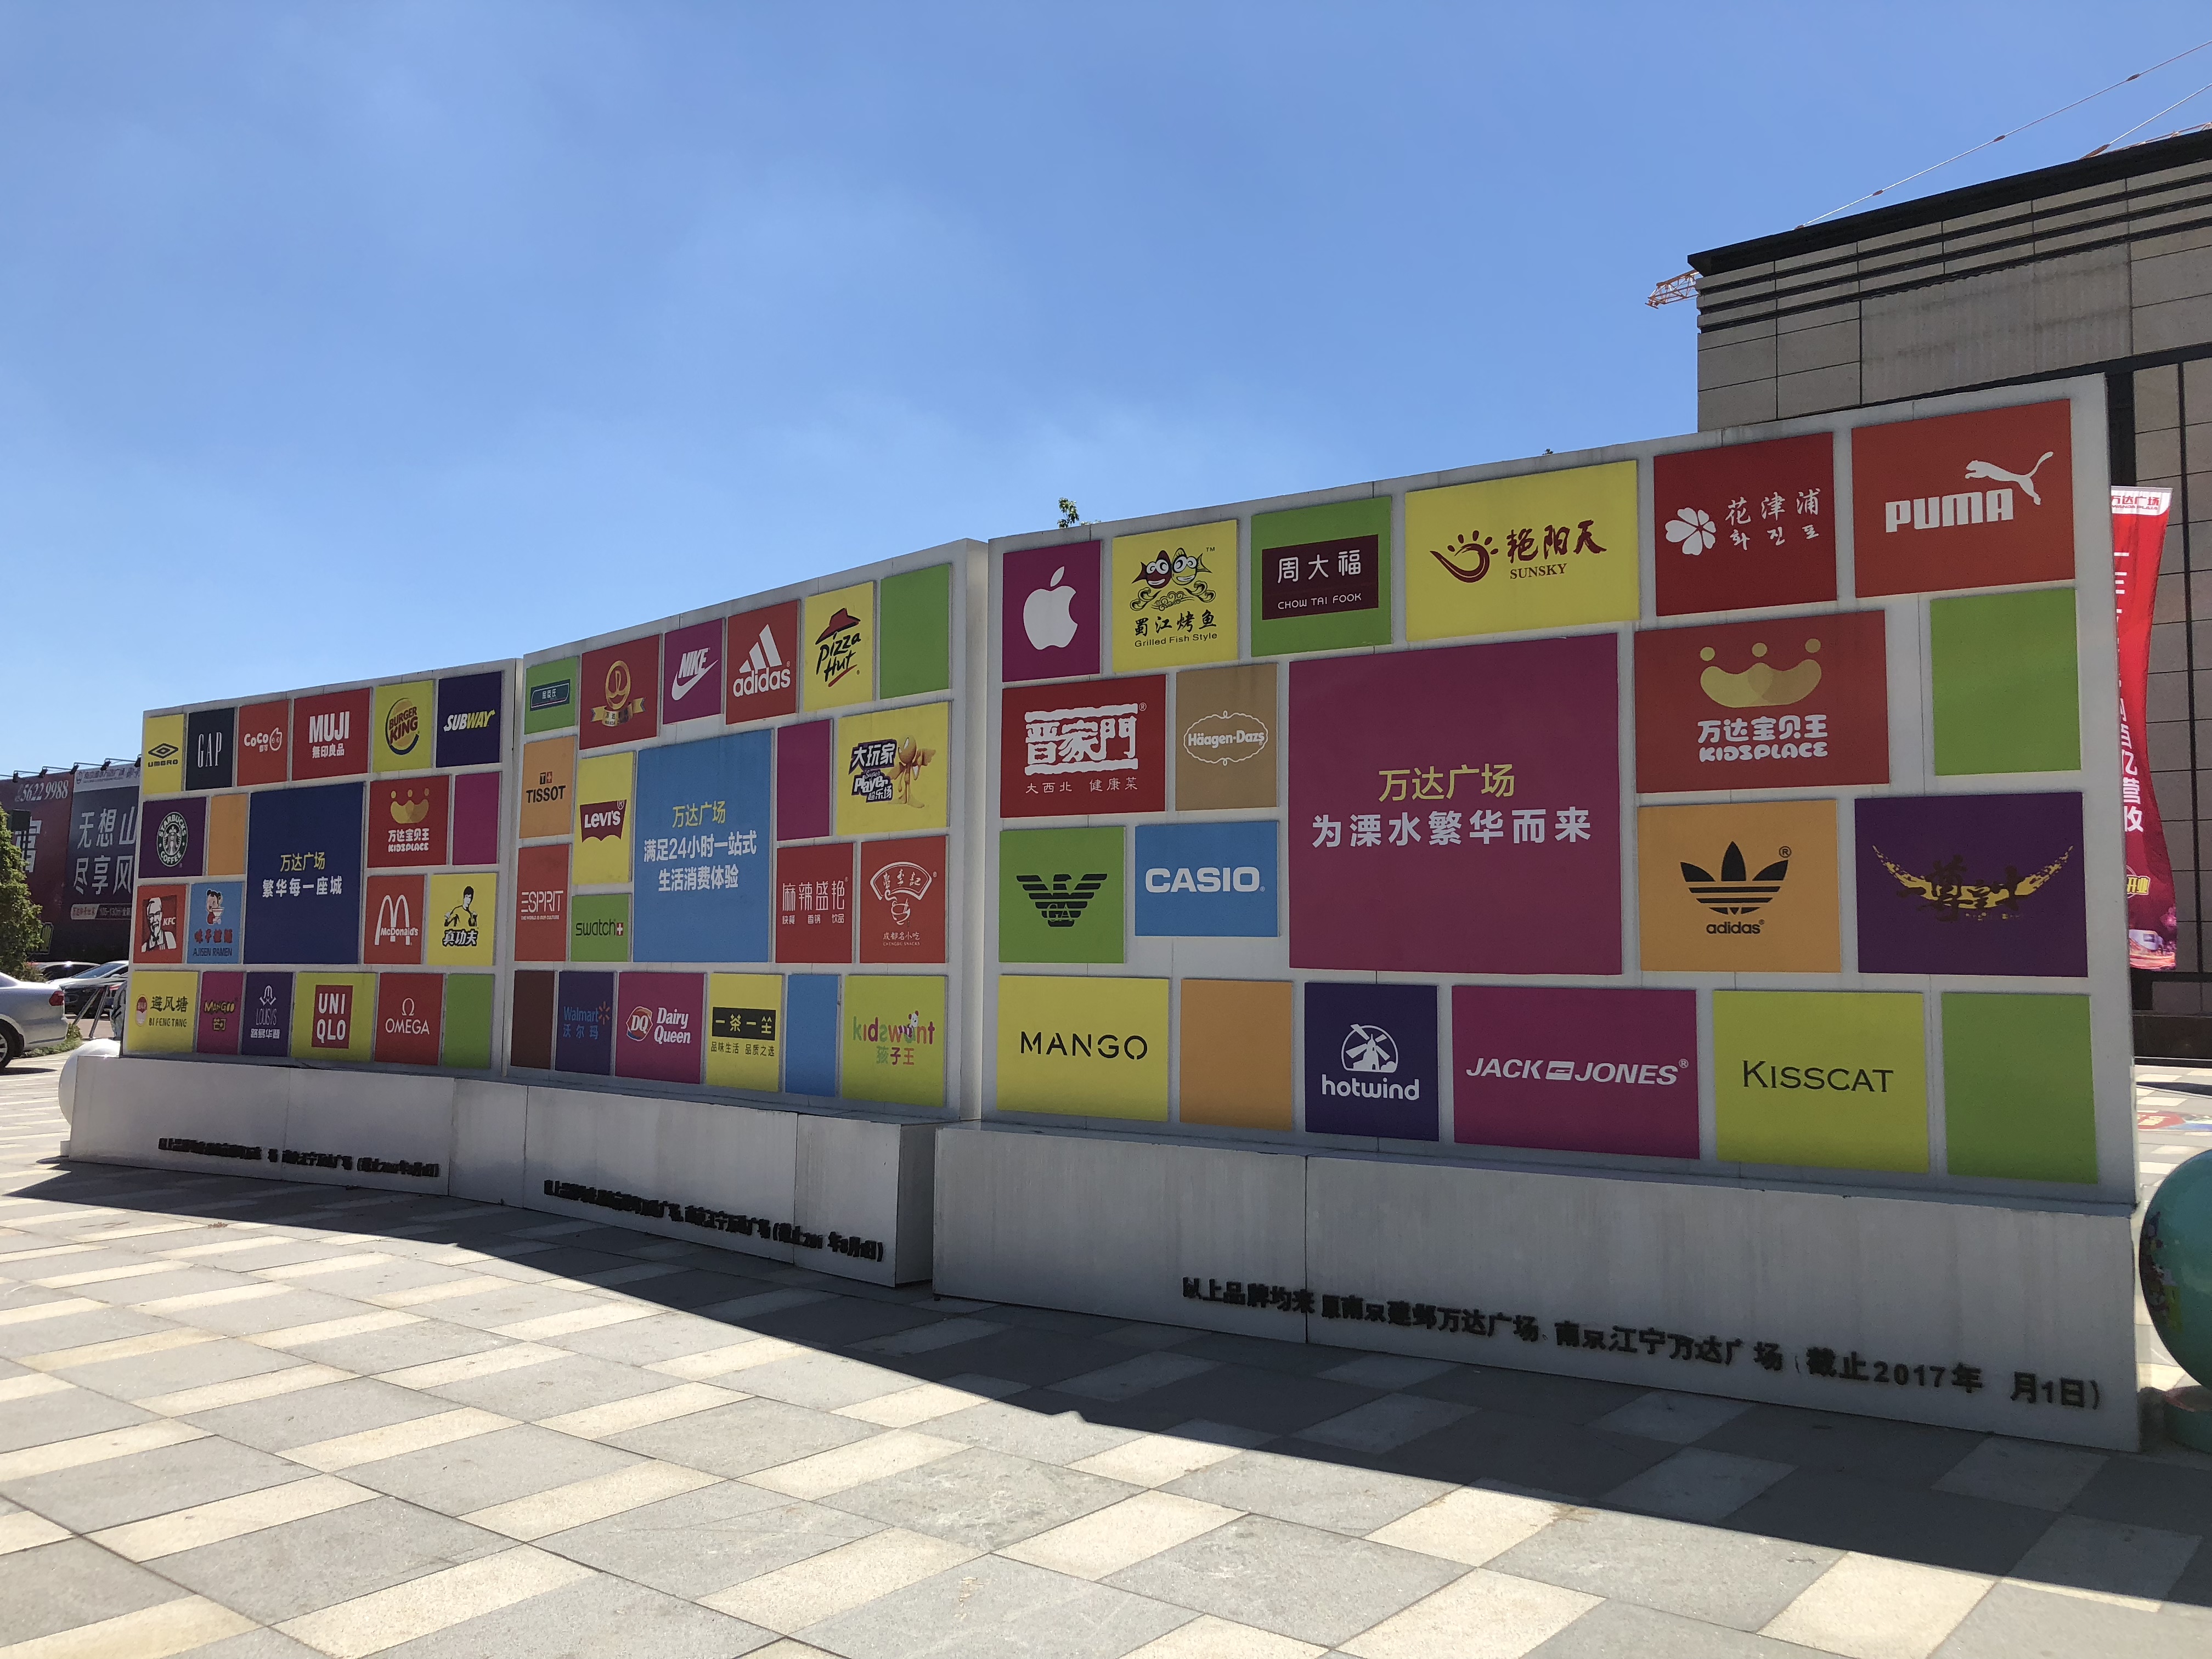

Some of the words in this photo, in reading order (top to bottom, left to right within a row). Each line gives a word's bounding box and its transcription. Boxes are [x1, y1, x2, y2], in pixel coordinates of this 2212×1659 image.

[1725, 488, 1821, 526] 花津浦
[1885, 488, 2014, 533] PUMA
[2112, 495, 2160, 506] 万达广场
[1506, 519, 1607, 564] 艳阳天
[1277, 549, 1361, 584] 周大福
[1510, 563, 1567, 579] SUNSKY
[1278, 599, 1307, 610] CHOW
[1311, 596, 1328, 606] TAI
[1333, 592, 1362, 604] FOOK
[1135, 609, 1217, 637] 蜀江烤鱼
[1135, 637, 1166, 647] Grilled
[1169, 635, 1189, 644] Fish
[1192, 632, 1217, 641] Style
[678, 647, 709, 679] NIKE
[816, 631, 861, 675] Pizza
[824, 650, 856, 682] Hut
[733, 667, 791, 697] adidas
[309, 711, 350, 743] MUJI
[389, 706, 417, 729] BURGER
[443, 709, 496, 732] SUBWAY
[1697, 714, 1828, 743] 万达宝贝王
[389, 715, 419, 745] KING
[198, 732, 223, 768] GAP
[312, 743, 345, 759] 無印良品
[851, 742, 896, 768] 大玩家
[1699, 742, 1828, 763] KIDSPLACE
[44, 780, 69, 800] 9988
[854, 775, 889, 793] Player
[867, 785, 892, 800] 超乐场
[1025, 781, 1073, 794] 大西北
[1089, 776, 1138, 793] 健康菜
[1378, 763, 1515, 803] 万达广场
[526, 785, 566, 804] TISSOT
[672, 800, 726, 828] 万达广场
[77, 806, 137, 850] 无想山
[159, 814, 187, 838] STARBUCKS
[388, 828, 430, 843] 万达宝贝王
[1312, 806, 1591, 848] 为溧水繁华而来
[160, 850, 182, 864] COFFEE
[644, 830, 757, 862] 满足24小时一站式
[280, 851, 326, 872] 万达广场
[74, 855, 133, 895] 尽享风
[658, 864, 739, 892] 生活消费体验
[1145, 866, 1260, 893] CASIO
[262, 876, 343, 898] 繁华每一座城
[782, 880, 845, 912] 麻辣盛艳
[521, 890, 564, 913] ESPRIT
[163, 917, 176, 926] KFC
[575, 918, 616, 936] swatch
[831, 913, 845, 924] 饮品
[1706, 921, 1761, 935] adidas
[380, 927, 419, 936] McDonald's
[442, 928, 477, 947] 真功夫
[883, 930, 921, 940] 成都名小吃
[212, 947, 233, 957] RAMEN
[150, 996, 189, 1013] 避风塘
[318, 993, 346, 1014] UNI
[563, 1006, 599, 1023] Walmart
[385, 1018, 430, 1035] OMEGA
[630, 1015, 649, 1034] DQ
[656, 1007, 689, 1029] Dairy
[316, 1019, 346, 1043] QLO
[562, 1023, 599, 1040] 沃尔玛
[654, 1025, 691, 1045] Queen
[710, 1041, 740, 1054] 品味生活
[745, 1043, 775, 1057] 品质之选
[876, 1046, 915, 1066] 孩子王
[1020, 1031, 1148, 1060] MANGO
[1466, 1057, 1544, 1080] JACK
[1575, 1061, 1679, 1086] JONES
[1322, 1074, 1420, 1101] hotwind
